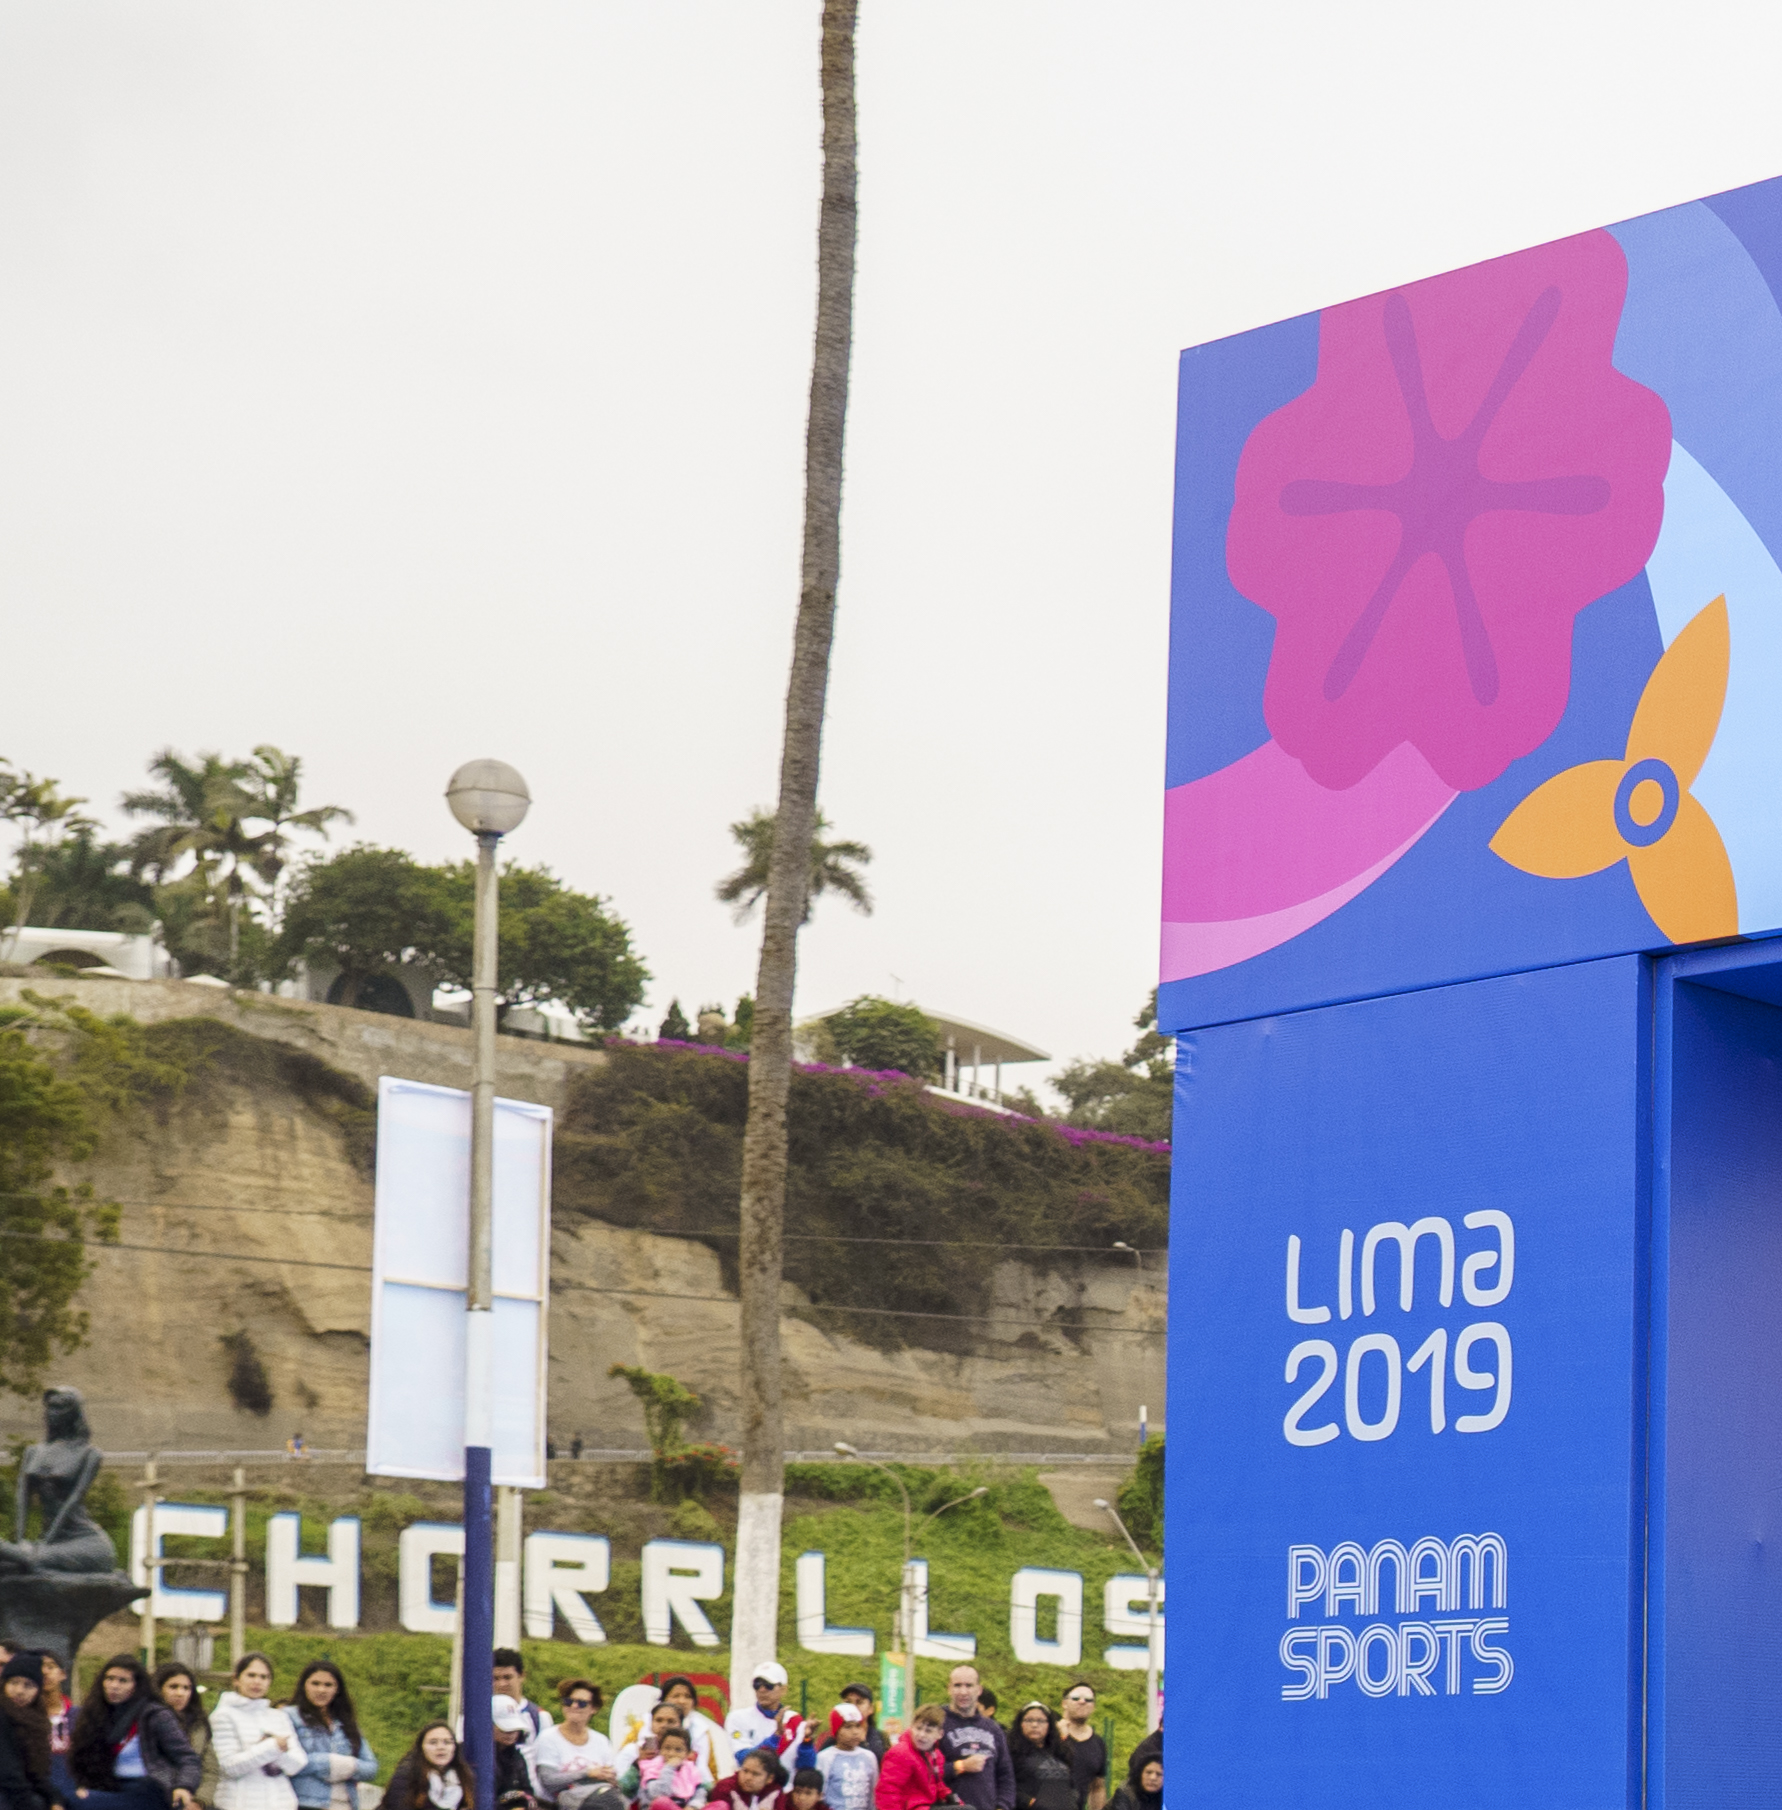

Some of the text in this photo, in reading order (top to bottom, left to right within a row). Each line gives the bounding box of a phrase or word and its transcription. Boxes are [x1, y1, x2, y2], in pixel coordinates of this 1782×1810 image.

[1283, 1321, 1513, 1447] 2019
[131, 1503, 1164, 1672] CHORRLLOS
[1287, 1532, 1508, 1619] PANAM
[1279, 1616, 1514, 1701] SPORTS
